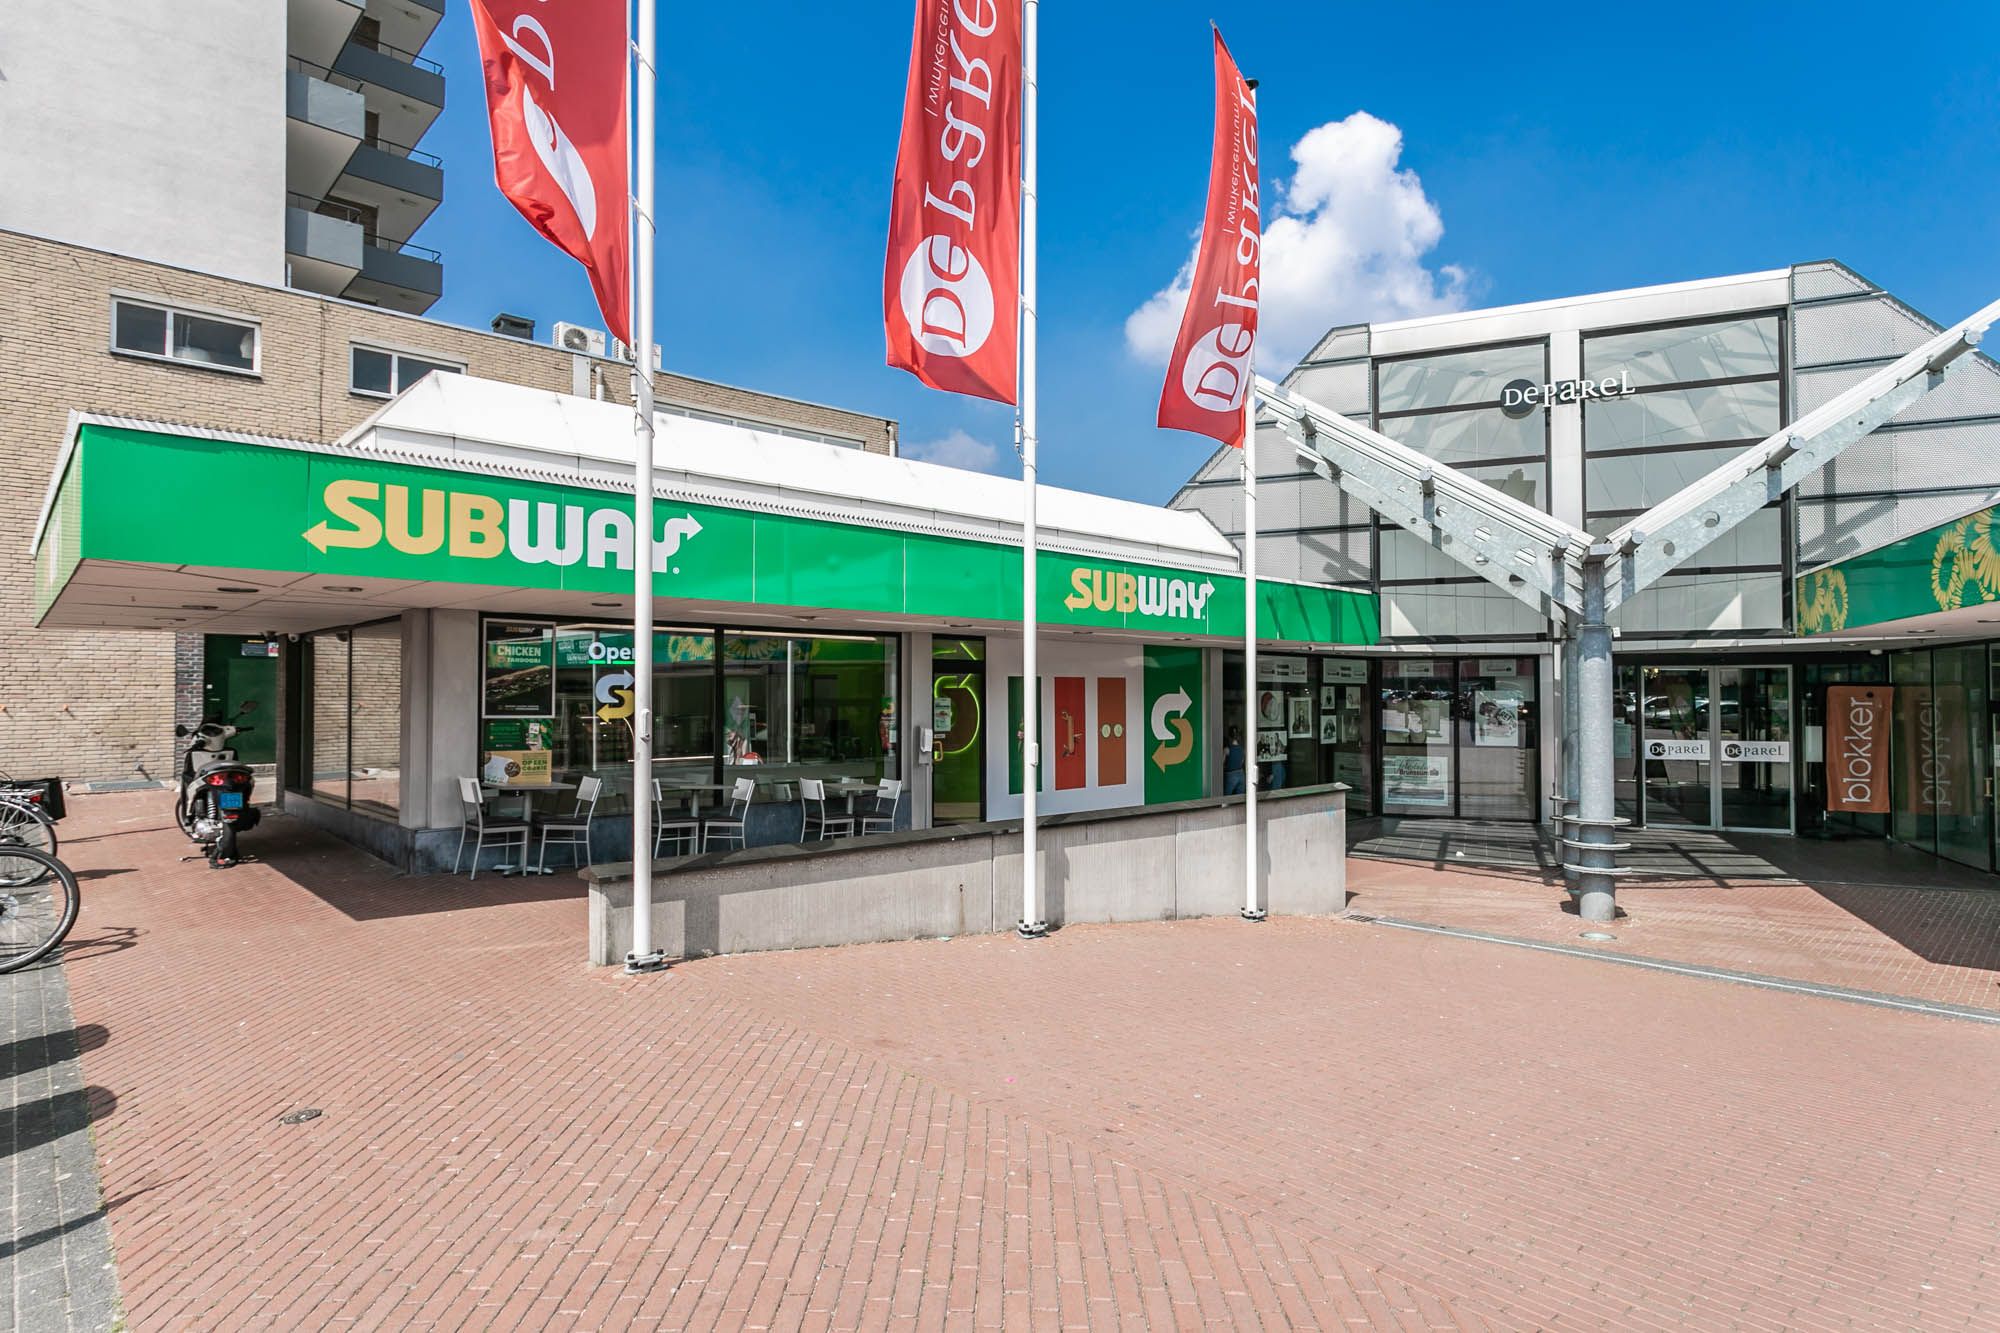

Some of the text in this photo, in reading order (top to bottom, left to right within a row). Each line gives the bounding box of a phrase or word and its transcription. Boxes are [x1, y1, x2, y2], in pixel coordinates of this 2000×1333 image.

[301, 479, 703, 573] SUBWAY
[1063, 567, 1216, 620] SUBWAY
[497, 645, 542, 657] CHICKEN
[588, 641, 635, 665] Ope
[1841, 696, 1874, 804] blokker
